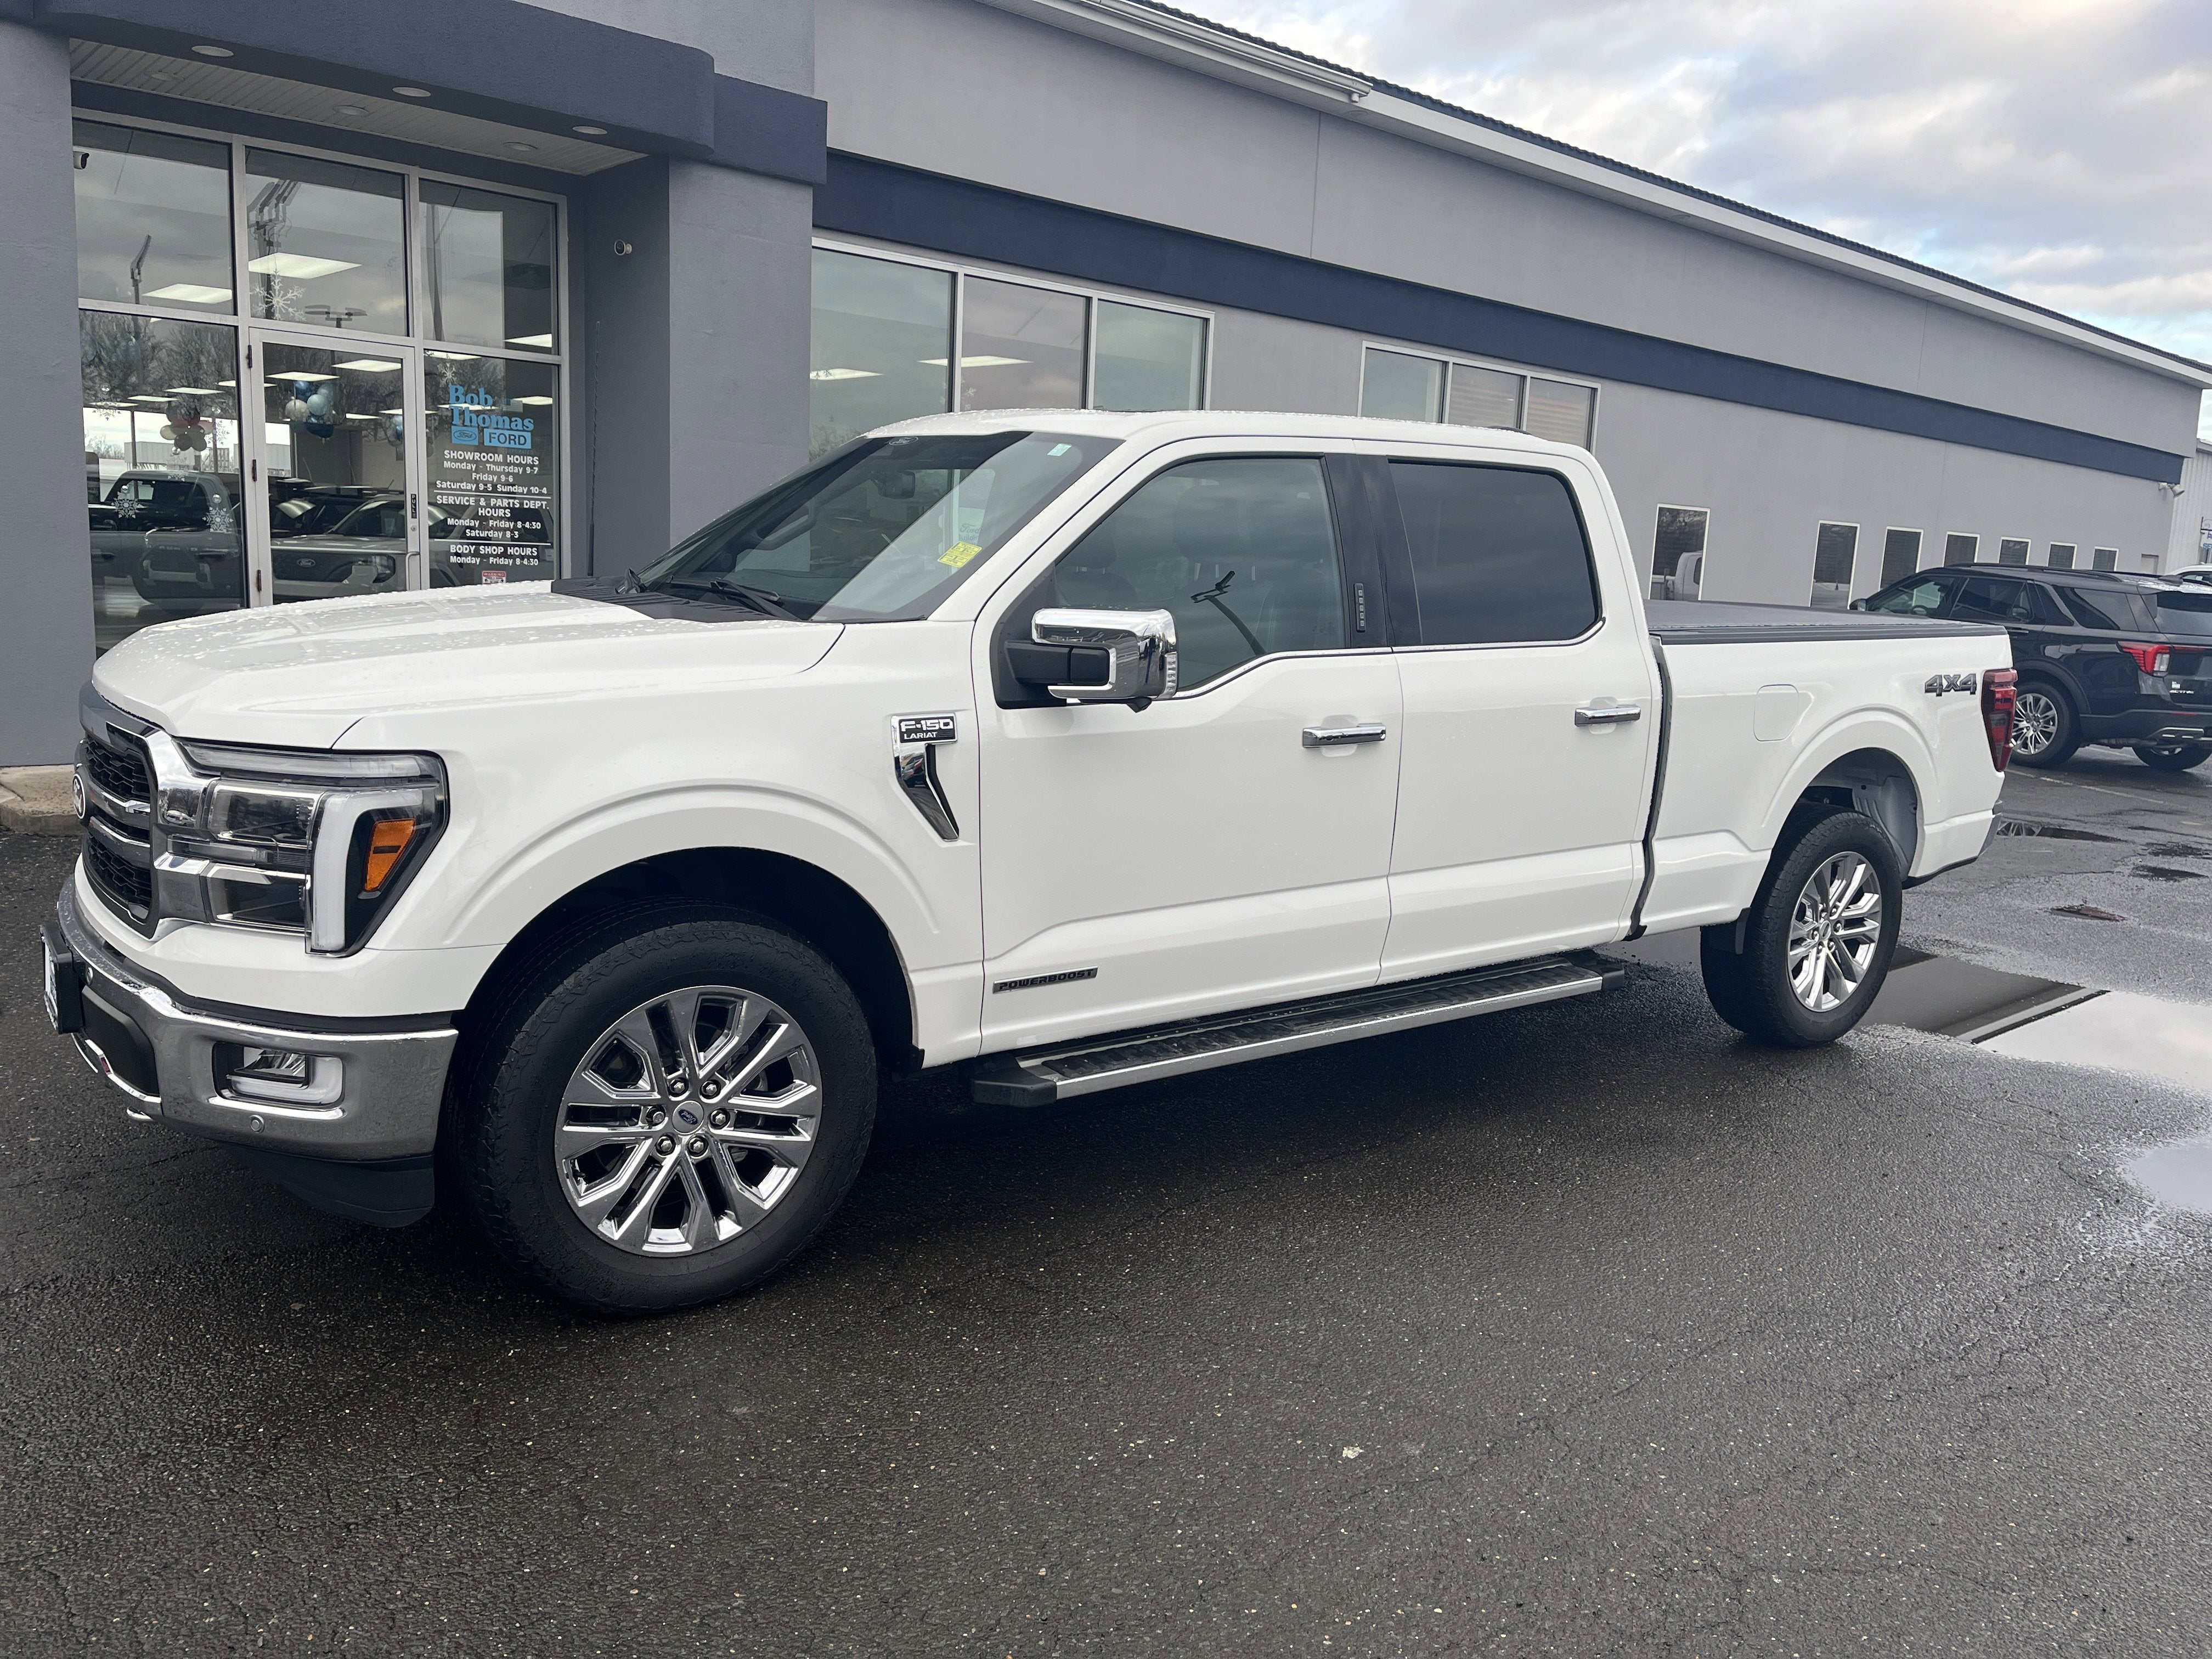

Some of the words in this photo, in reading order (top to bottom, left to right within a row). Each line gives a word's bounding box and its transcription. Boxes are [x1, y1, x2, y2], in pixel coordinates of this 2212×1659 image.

[448, 384, 493, 407] Bob
[449, 405, 534, 431] Thomas
[489, 432, 527, 445] FORD
[444, 450, 503, 462] SHOWROOM
[507, 454, 539, 465] HOURS
[443, 461, 476, 471] Monday
[486, 464, 523, 474] Thursday
[472, 473, 498, 482] Friday
[436, 481, 476, 490] Saturday
[496, 484, 528, 494] Sunday
[436, 495, 475, 505] SERVICE
[479, 498, 486, 506] &
[490, 499, 520, 507] PARTS
[523, 500, 549, 510] DEPT.
[478, 507, 511, 517] HOURS
[447, 518, 479, 527] Monday
[489, 520, 514, 529] Friday
[517, 521, 541, 529] 8-4:30
[466, 529, 503, 538] Saturday
[450, 545, 476, 554] BODY
[479, 545, 504, 554] SHOP
[507, 546, 538, 556] HOURS
[450, 556, 480, 565] Monday
[489, 557, 513, 566] Friday
[900, 719, 953, 731] F-150
[999, 969, 1094, 990] POWERBOOST
